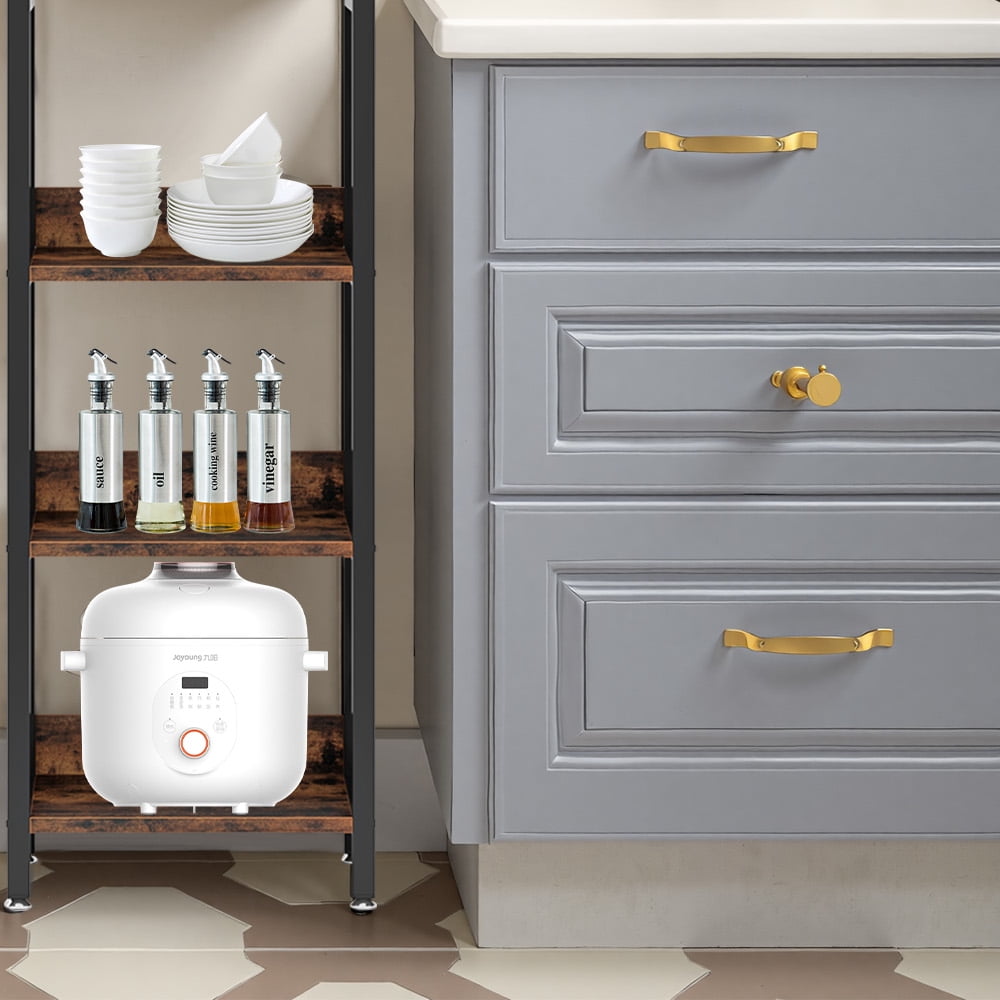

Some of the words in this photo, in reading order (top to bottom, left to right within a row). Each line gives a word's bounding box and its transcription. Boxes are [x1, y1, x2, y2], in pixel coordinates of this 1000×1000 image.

[208, 431, 217, 454] wine
[95, 456, 105, 489] sauce
[152, 472, 165, 488] oil
[208, 455, 220, 491] cooking
[262, 442, 278, 494] vinegar
